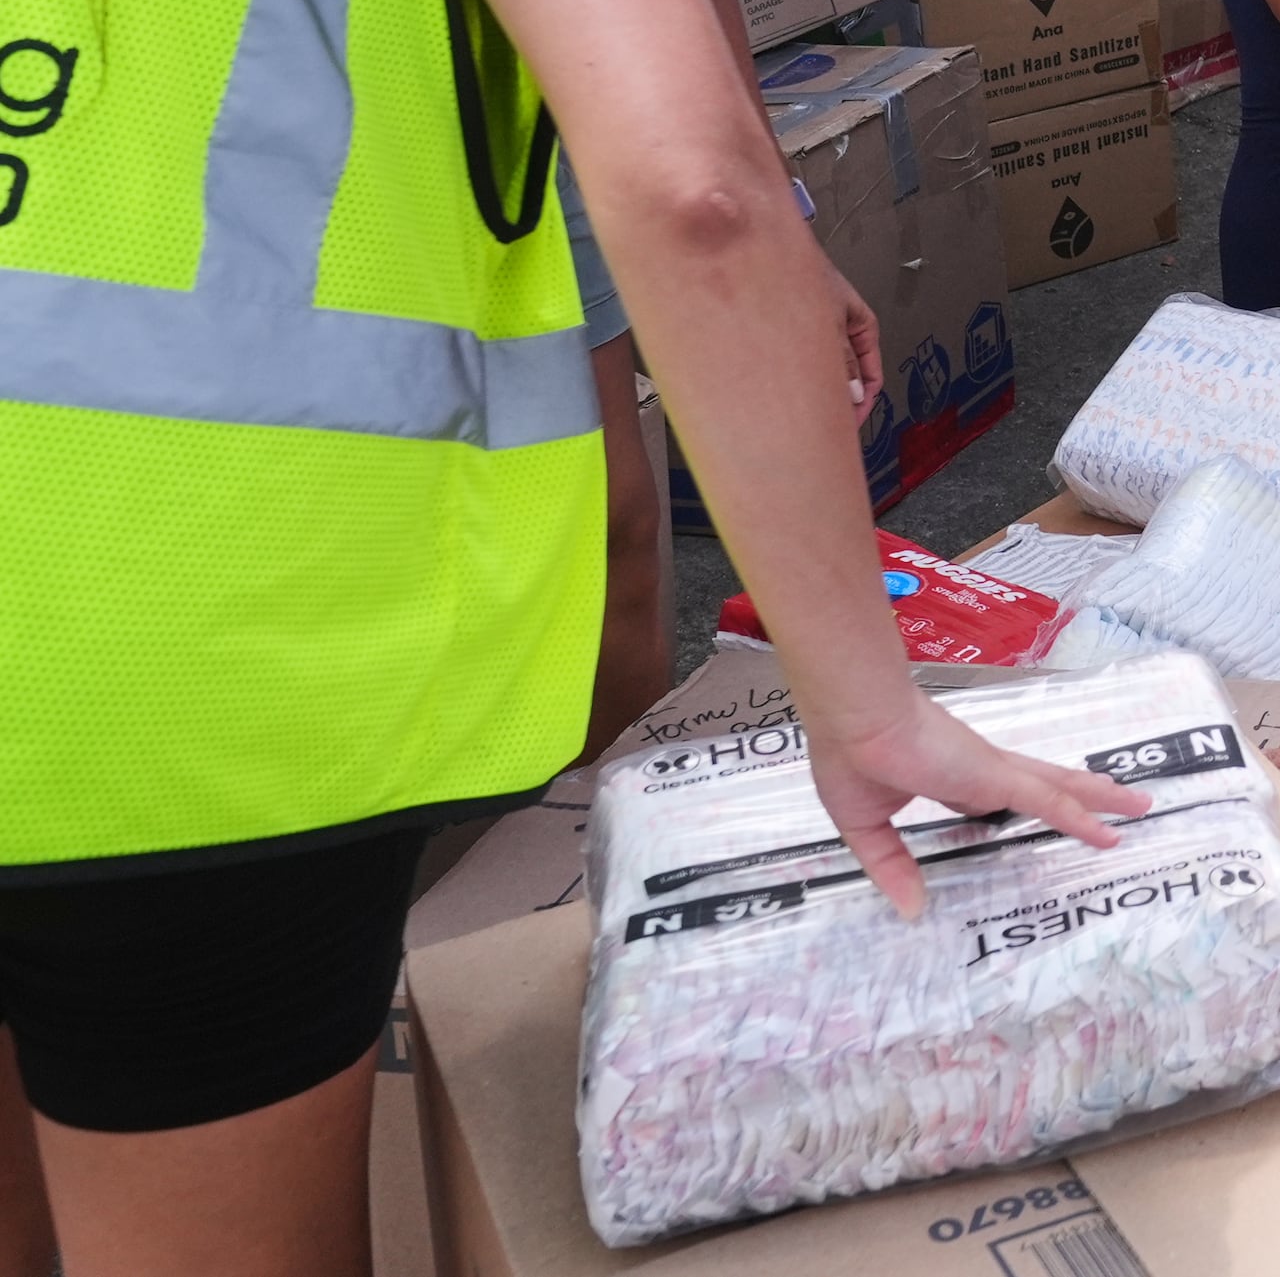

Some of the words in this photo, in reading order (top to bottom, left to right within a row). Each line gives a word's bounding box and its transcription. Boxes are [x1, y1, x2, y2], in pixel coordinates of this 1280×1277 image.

[751, 13, 775, 27] ATTIC
[1031, 25, 1064, 42] Ana
[1023, 52, 1062, 74] Hand
[1070, 35, 1140, 61] Sanitizer
[1028, 76, 1052, 89] MADE
[1054, 74, 1063, 84] IN
[1065, 68, 1090, 81] CHINA
[1023, 134, 1050, 147] CHINA
[1051, 132, 1060, 140] IN
[1062, 126, 1085, 138] MADE
[1098, 124, 1148, 145] Instant
[1053, 140, 1090, 162] Hand
[1051, 171, 1082, 189] Ana
[889, 549, 1028, 603] HUGGIES
[932, 586, 988, 613] snugglers
[936, 636, 956, 646] 31
[953, 644, 982, 663] n
[1105, 742, 1167, 775] 36
[1190, 730, 1228, 758] N
[644, 773, 711, 794] Clean
[1122, 768, 1160, 781] diapers
[1198, 849, 1261, 864] Clean
[1067, 859, 1189, 902] Conscious
[966, 897, 1059, 927] Diapers
[967, 872, 1199, 969] HONEST
[928, 1179, 1090, 1242] 88670
